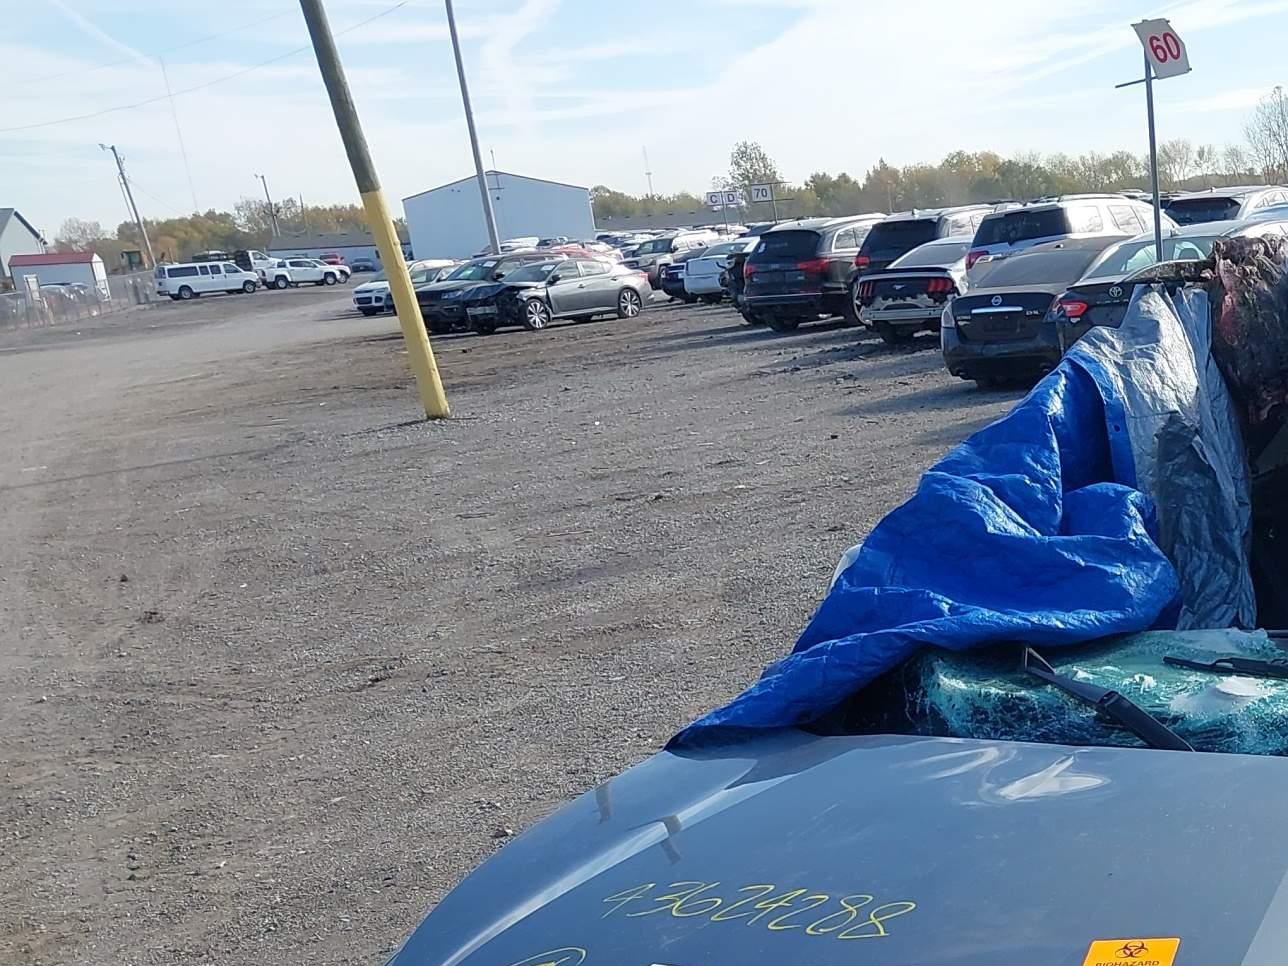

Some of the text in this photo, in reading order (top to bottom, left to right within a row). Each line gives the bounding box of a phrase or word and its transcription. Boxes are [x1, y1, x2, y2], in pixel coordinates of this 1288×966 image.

[1149, 32, 1180, 63] 60
[727, 193, 735, 202] D
[753, 188, 768, 198] 70
[709, 194, 718, 203] C
[601, 881, 916, 939] 43624288
